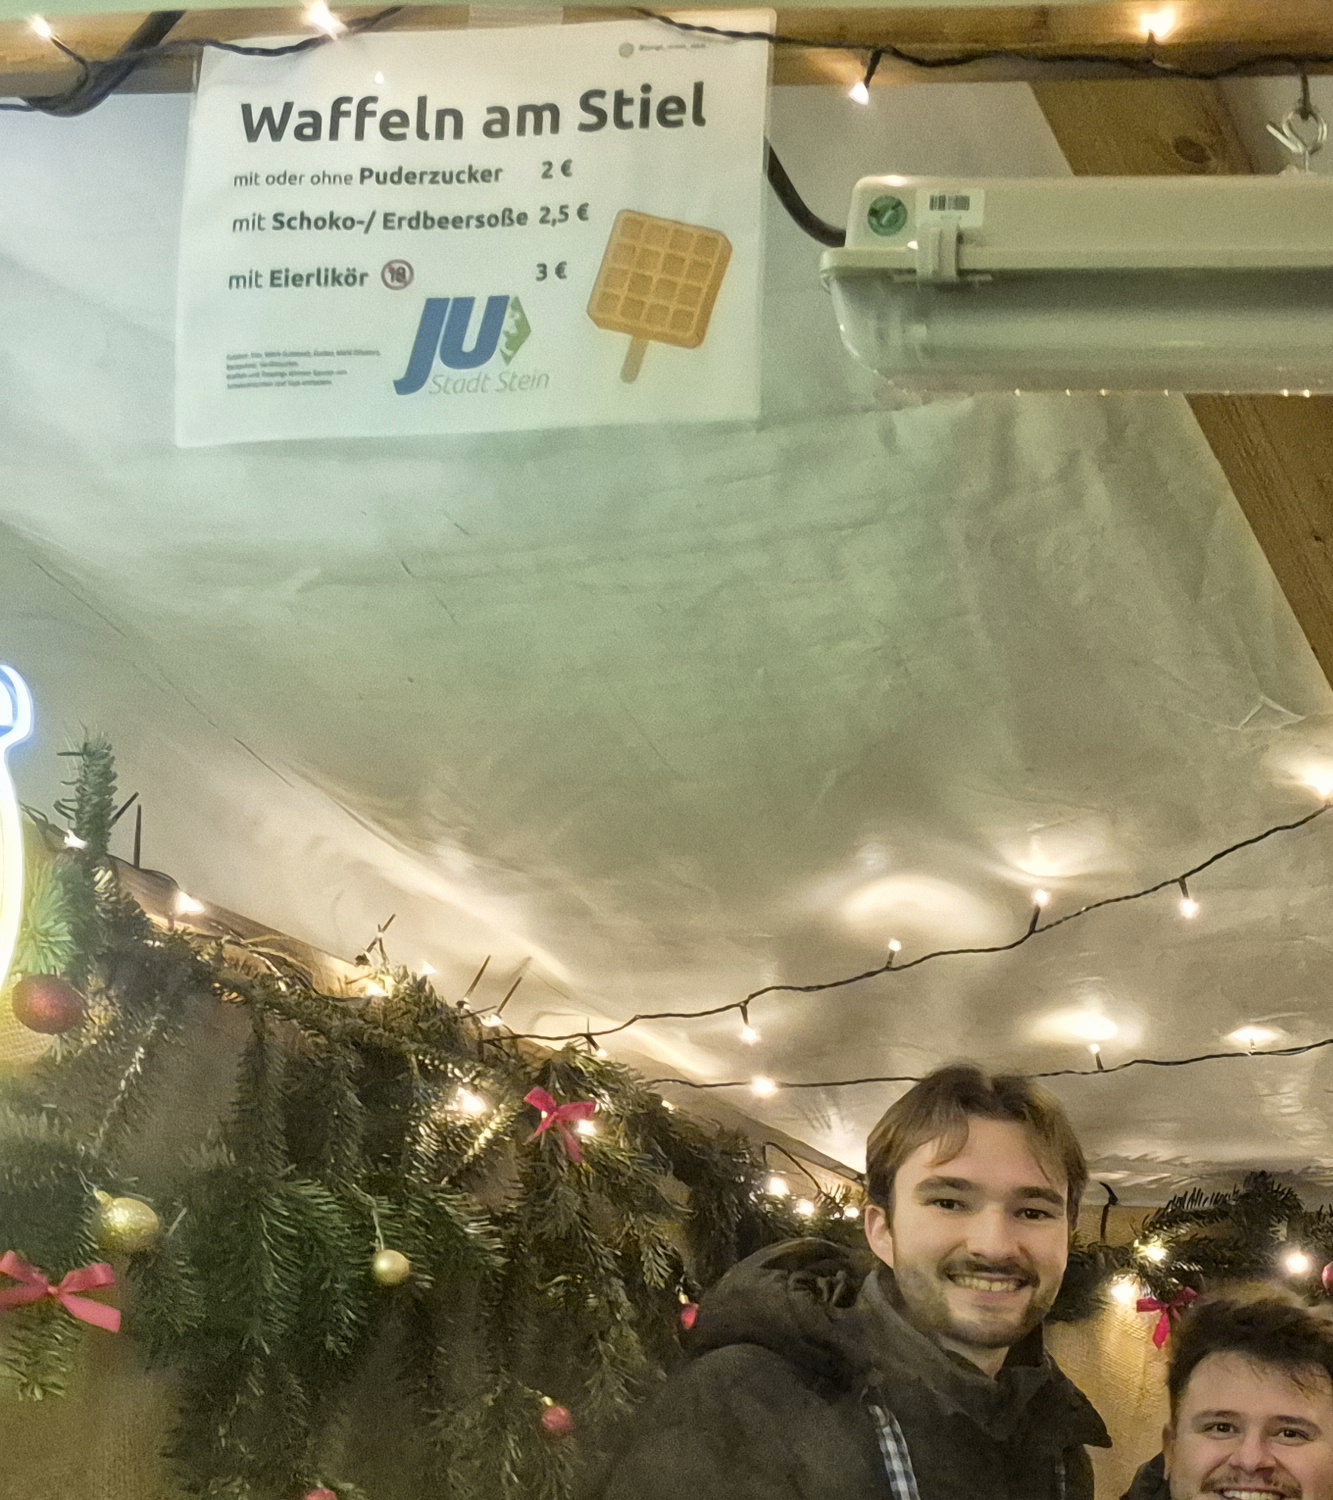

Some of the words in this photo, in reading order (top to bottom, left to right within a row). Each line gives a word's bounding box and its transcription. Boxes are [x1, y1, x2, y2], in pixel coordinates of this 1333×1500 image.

[240, 95, 464, 143] Waffeln
[482, 100, 560, 139] am
[577, 81, 707, 132] Stiel
[233, 171, 260, 188] mit
[265, 169, 305, 187] oder
[310, 168, 353, 187] ohne
[359, 163, 503, 186] Puderzucker
[541, 160, 554, 180] 2
[559, 159, 573, 178] €
[232, 212, 266, 234] mit
[272, 208, 377, 235] Schoko-/
[382, 206, 529, 233] Erdbeersoße
[538, 203, 570, 228] 2,5
[575, 202, 590, 223] €
[228, 269, 263, 291] mit
[268, 266, 369, 291] Eierlikör
[535, 262, 549, 283] 3
[553, 261, 568, 281] €
[393, 295, 510, 396] JU
[428, 372, 492, 396] Stadt
[495, 369, 550, 394] Stein
